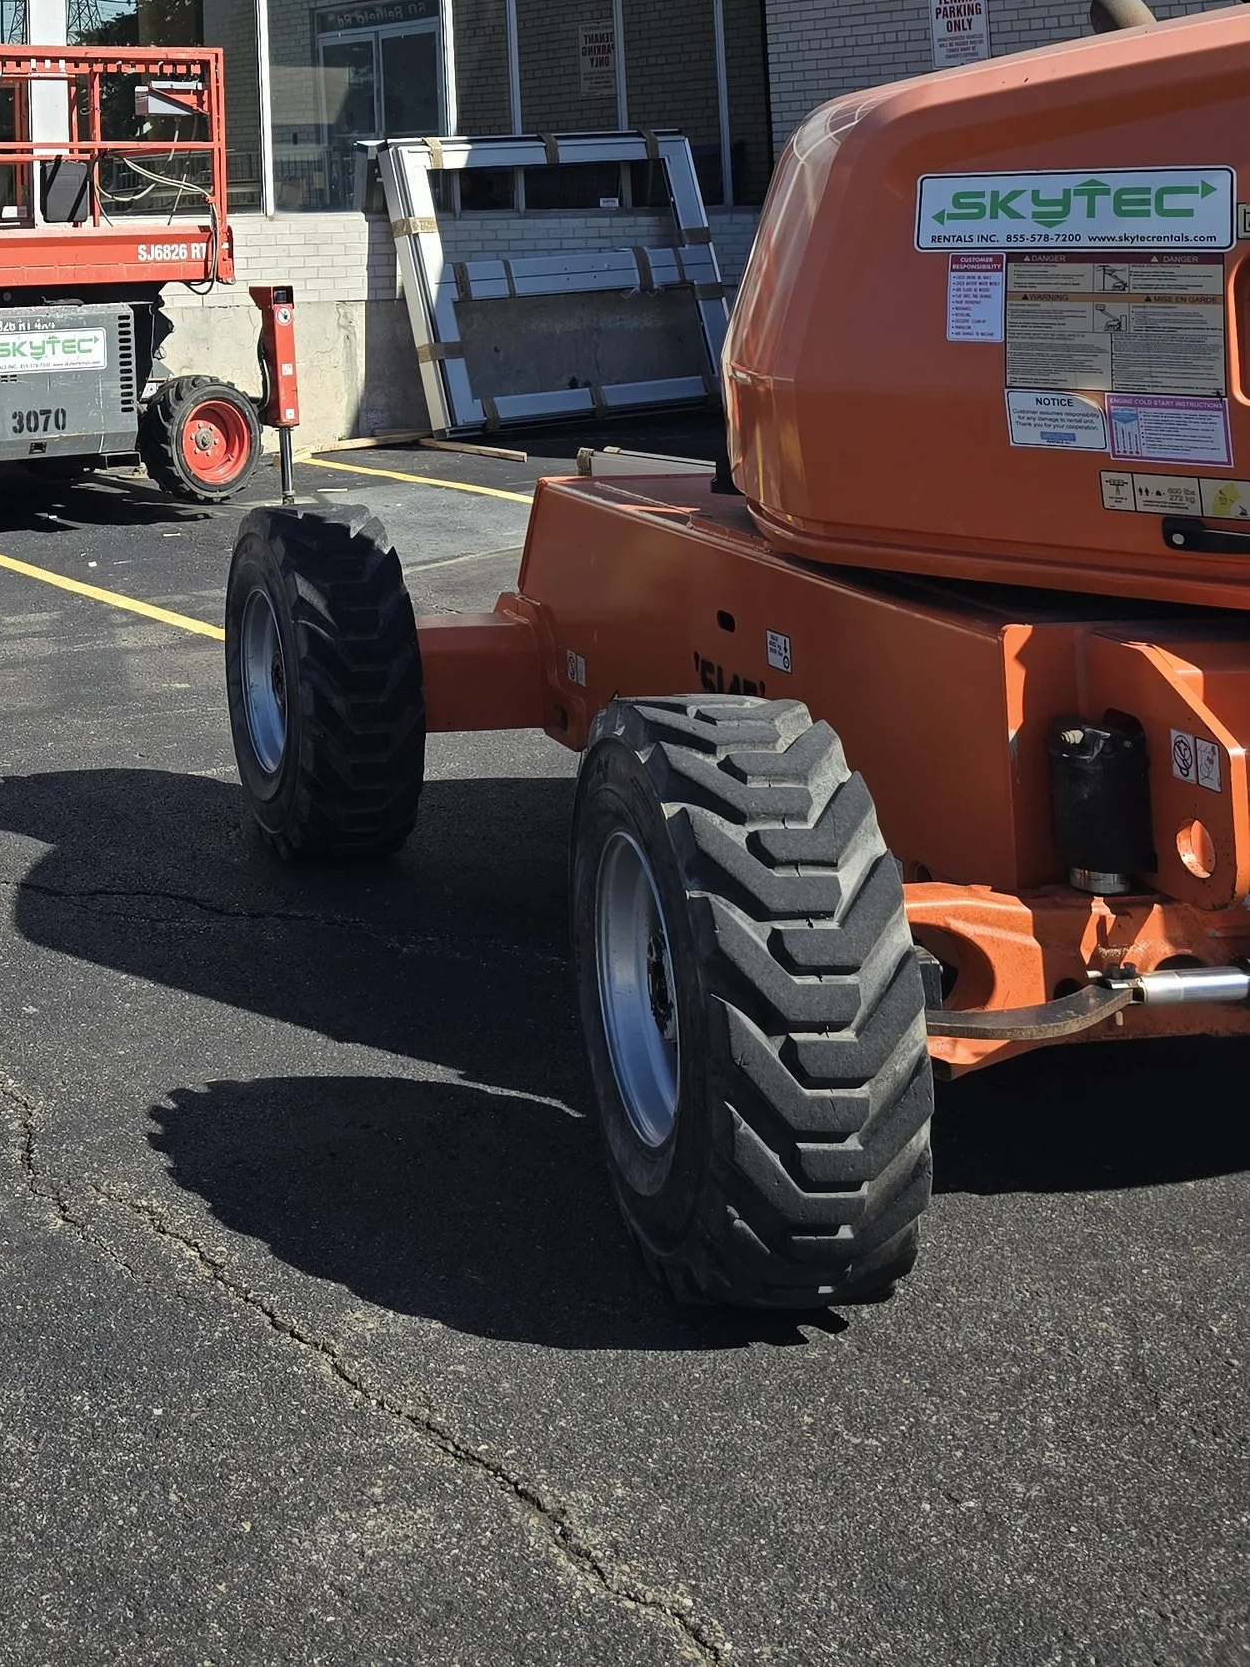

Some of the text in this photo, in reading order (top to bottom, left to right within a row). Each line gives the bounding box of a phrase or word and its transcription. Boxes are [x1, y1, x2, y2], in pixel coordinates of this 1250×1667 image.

[935, 2, 982, 19] PARKING
[946, 18, 973, 33] ONLY
[942, 179, 1205, 228] SKYTEC
[931, 232, 1217, 243] RENTALS INC. 855-578-7200 www.skytecrentals.com
[137, 242, 207, 261] SJ6826 RT
[1030, 294, 1069, 302] WARNING
[1153, 295, 1174, 303] MISE
[1035, 397, 1075, 407] NOTICE
[1175, 401, 1223, 409] INSTRUCTIONS
[1065, 411, 1099, 419] responsibility
[11, 408, 67, 434] 3070
[1185, 496, 1195, 504] kg
